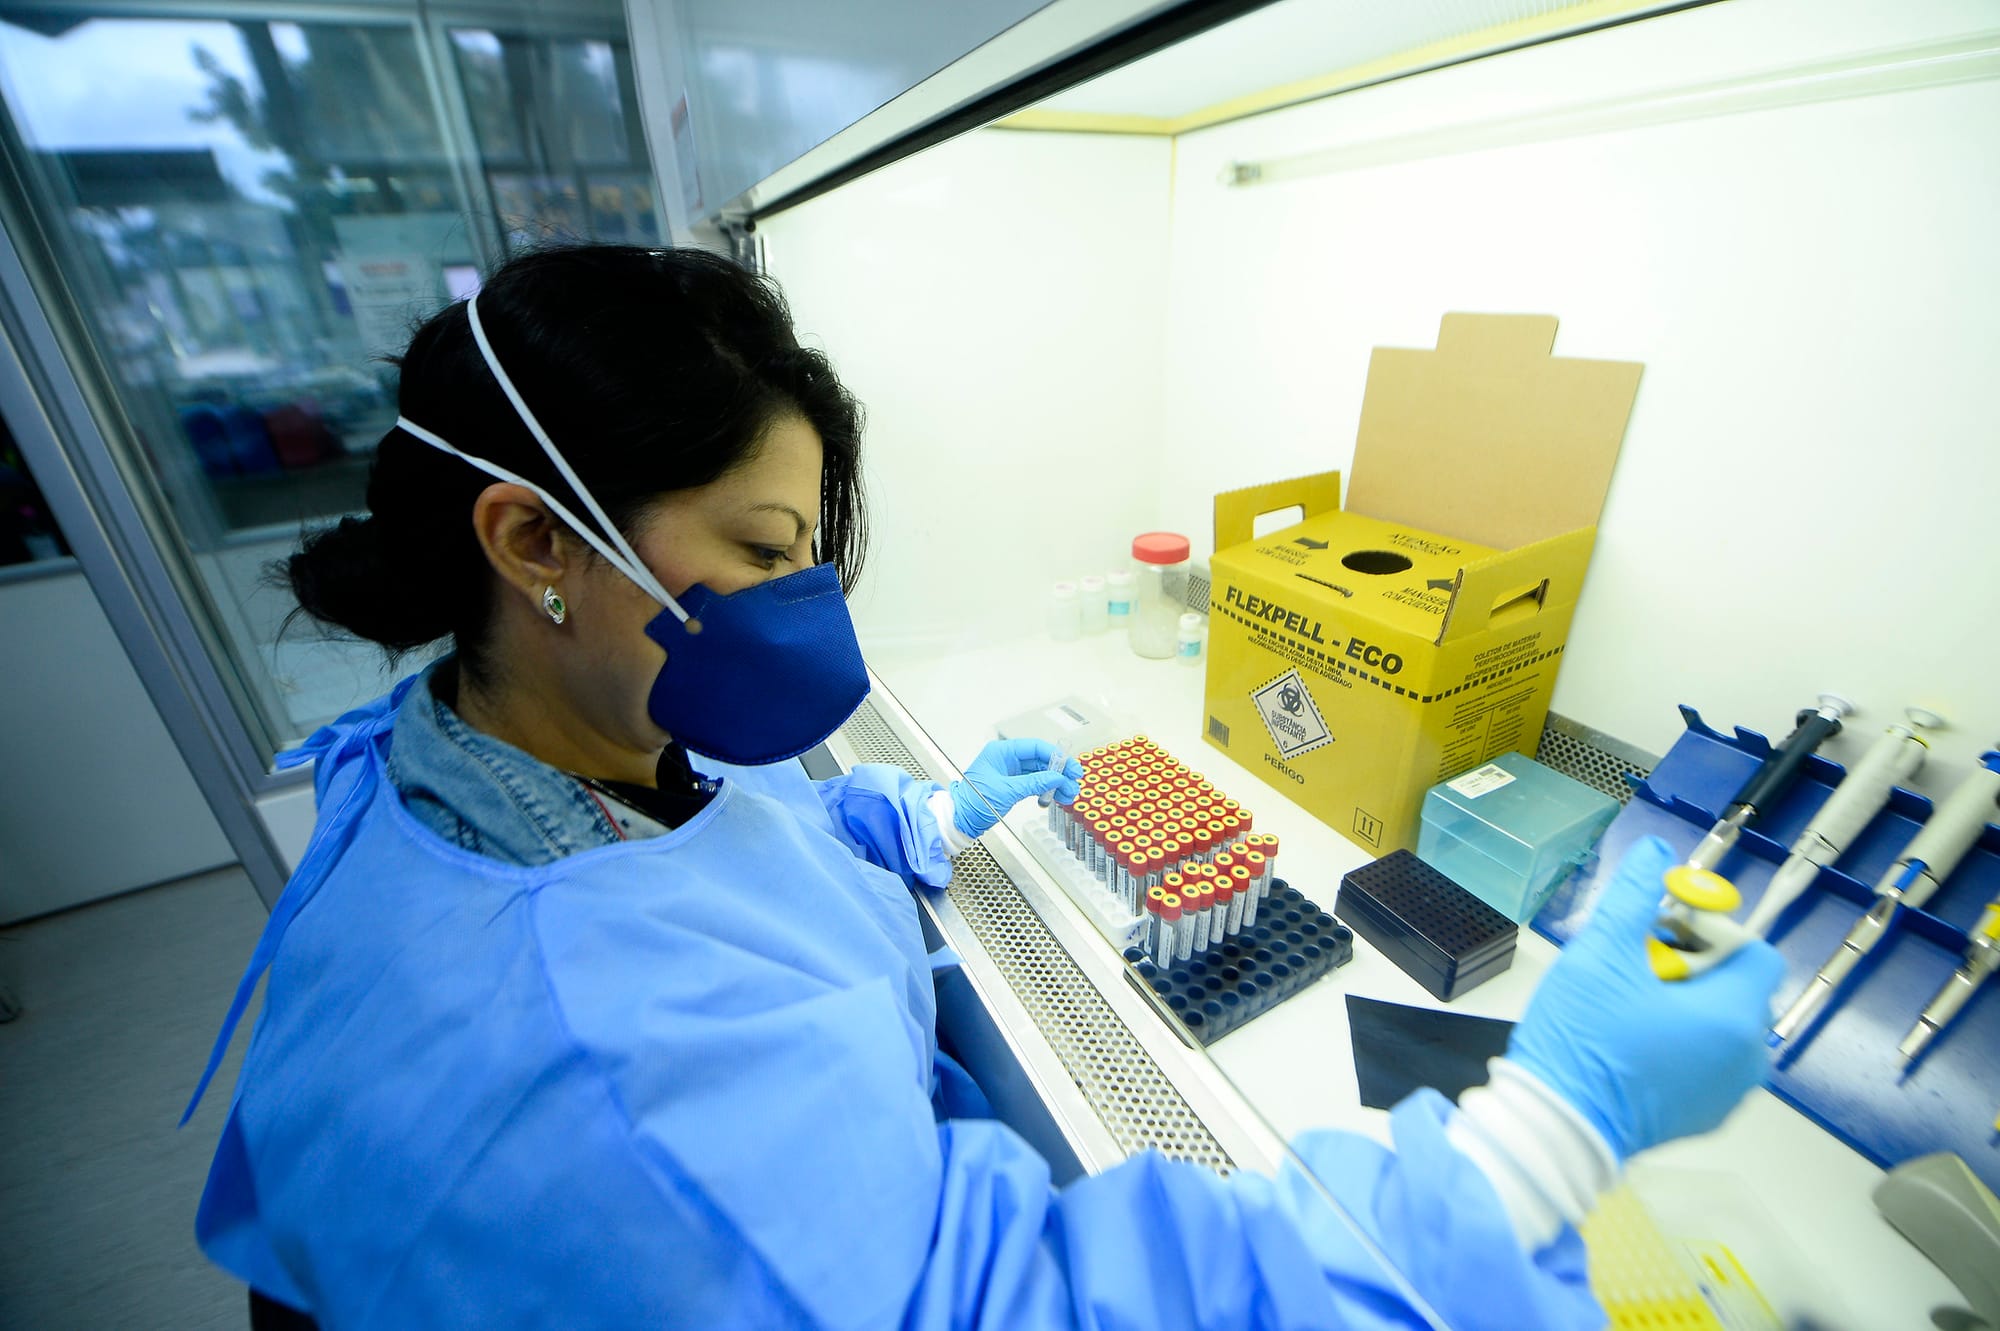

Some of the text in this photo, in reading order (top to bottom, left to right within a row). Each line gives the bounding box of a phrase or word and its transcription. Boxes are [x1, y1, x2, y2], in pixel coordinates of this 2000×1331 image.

[1225, 585, 1325, 644] FLEXPELL
[1345, 637, 1403, 675] ECO
[1264, 753, 1305, 785] PERIGO
